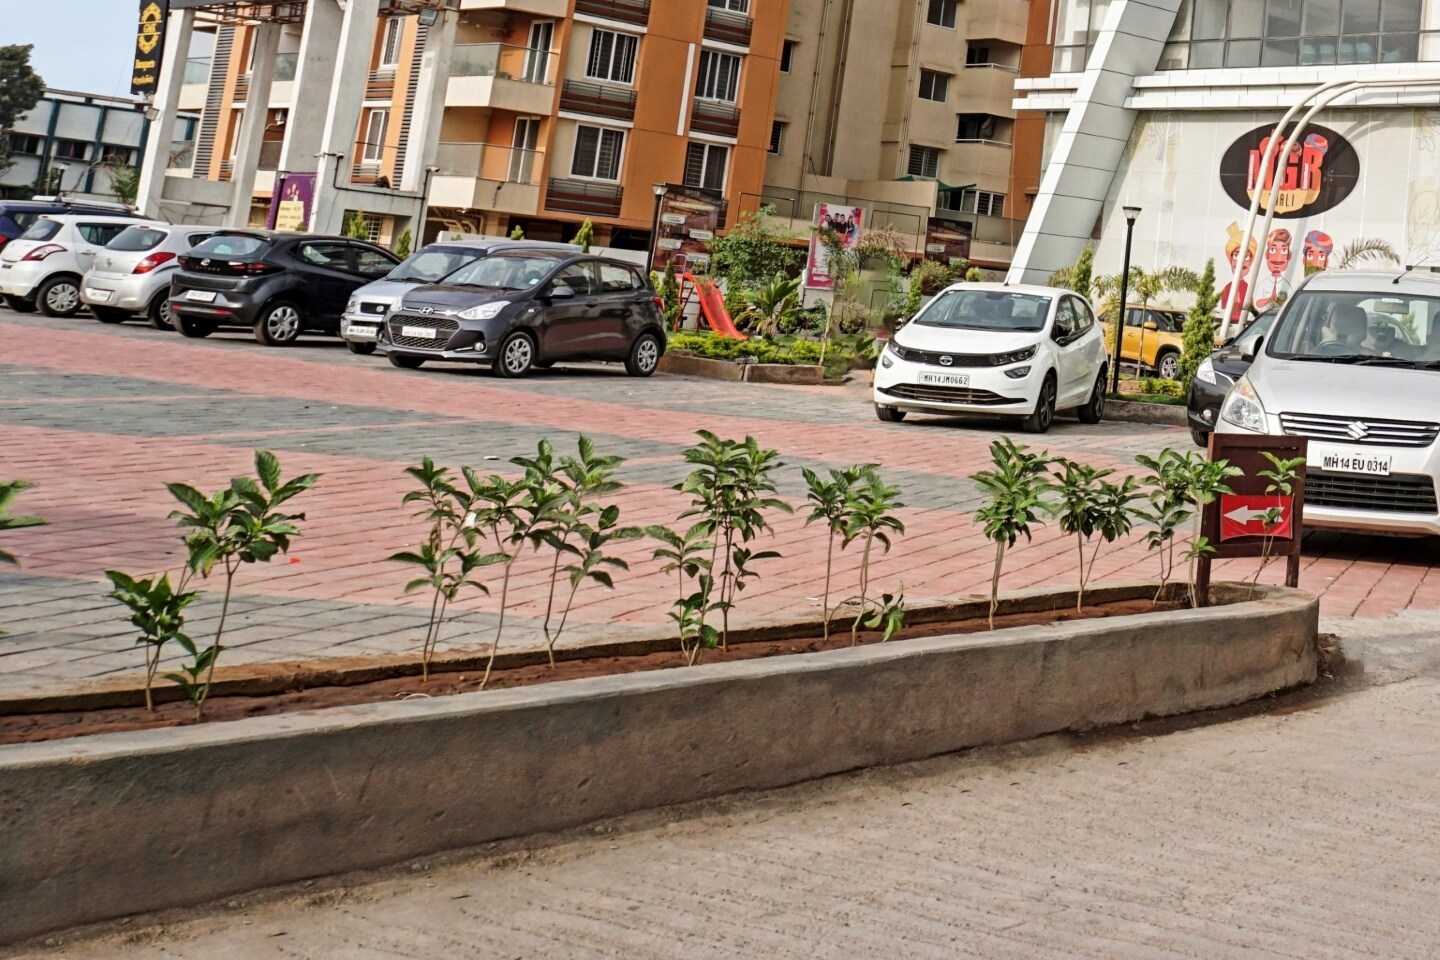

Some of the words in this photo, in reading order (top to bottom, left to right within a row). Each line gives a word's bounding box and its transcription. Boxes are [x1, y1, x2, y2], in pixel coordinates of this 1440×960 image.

[1269, 193, 1295, 207] ALI
[1323, 456, 1339, 468] MH
[1340, 458, 1350, 469] 14
[1352, 458, 1365, 471] EU
[1367, 460, 1388, 473] 0314
